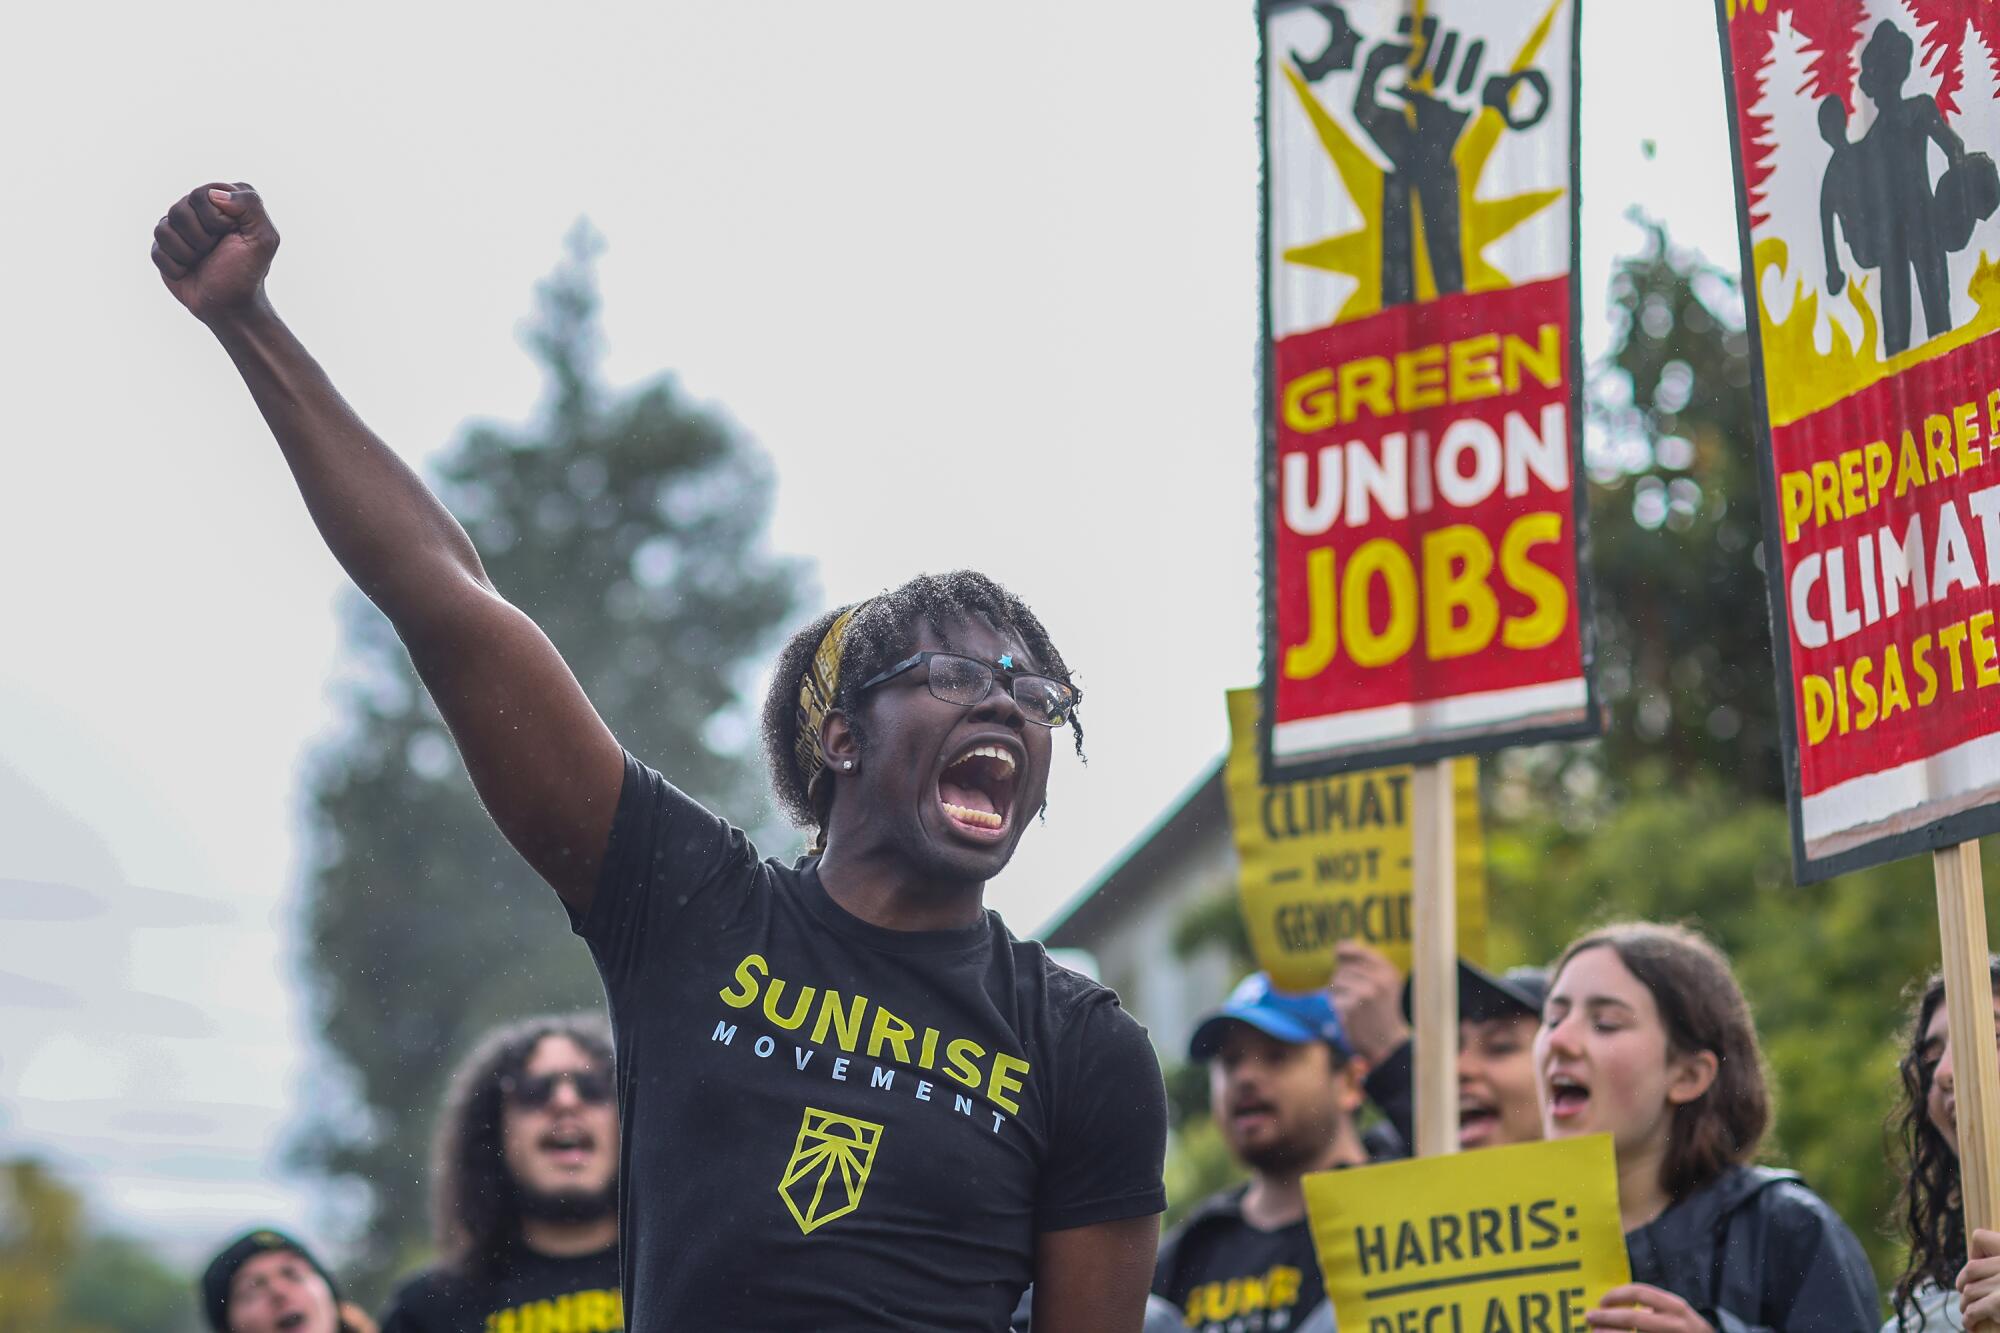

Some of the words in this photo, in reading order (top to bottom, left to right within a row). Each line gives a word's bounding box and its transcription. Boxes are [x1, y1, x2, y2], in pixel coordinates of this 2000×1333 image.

[1281, 324, 1561, 434] GREEN
[1283, 402, 1569, 535] UNION
[1781, 402, 1983, 544] PREPARE
[1284, 512, 1568, 680] JOBS
[1791, 484, 2000, 649] CLIMAT
[1803, 609, 2000, 746] DISASTE
[1262, 774, 1409, 840] CLIMAT
[1315, 850, 1379, 885] NOT
[1275, 893, 1411, 955] GENOCI
[711, 1020, 1006, 1134] MOVEMENT
[719, 954, 1030, 1116] SUNRISE
[1356, 1200, 1580, 1275] HARRIS:
